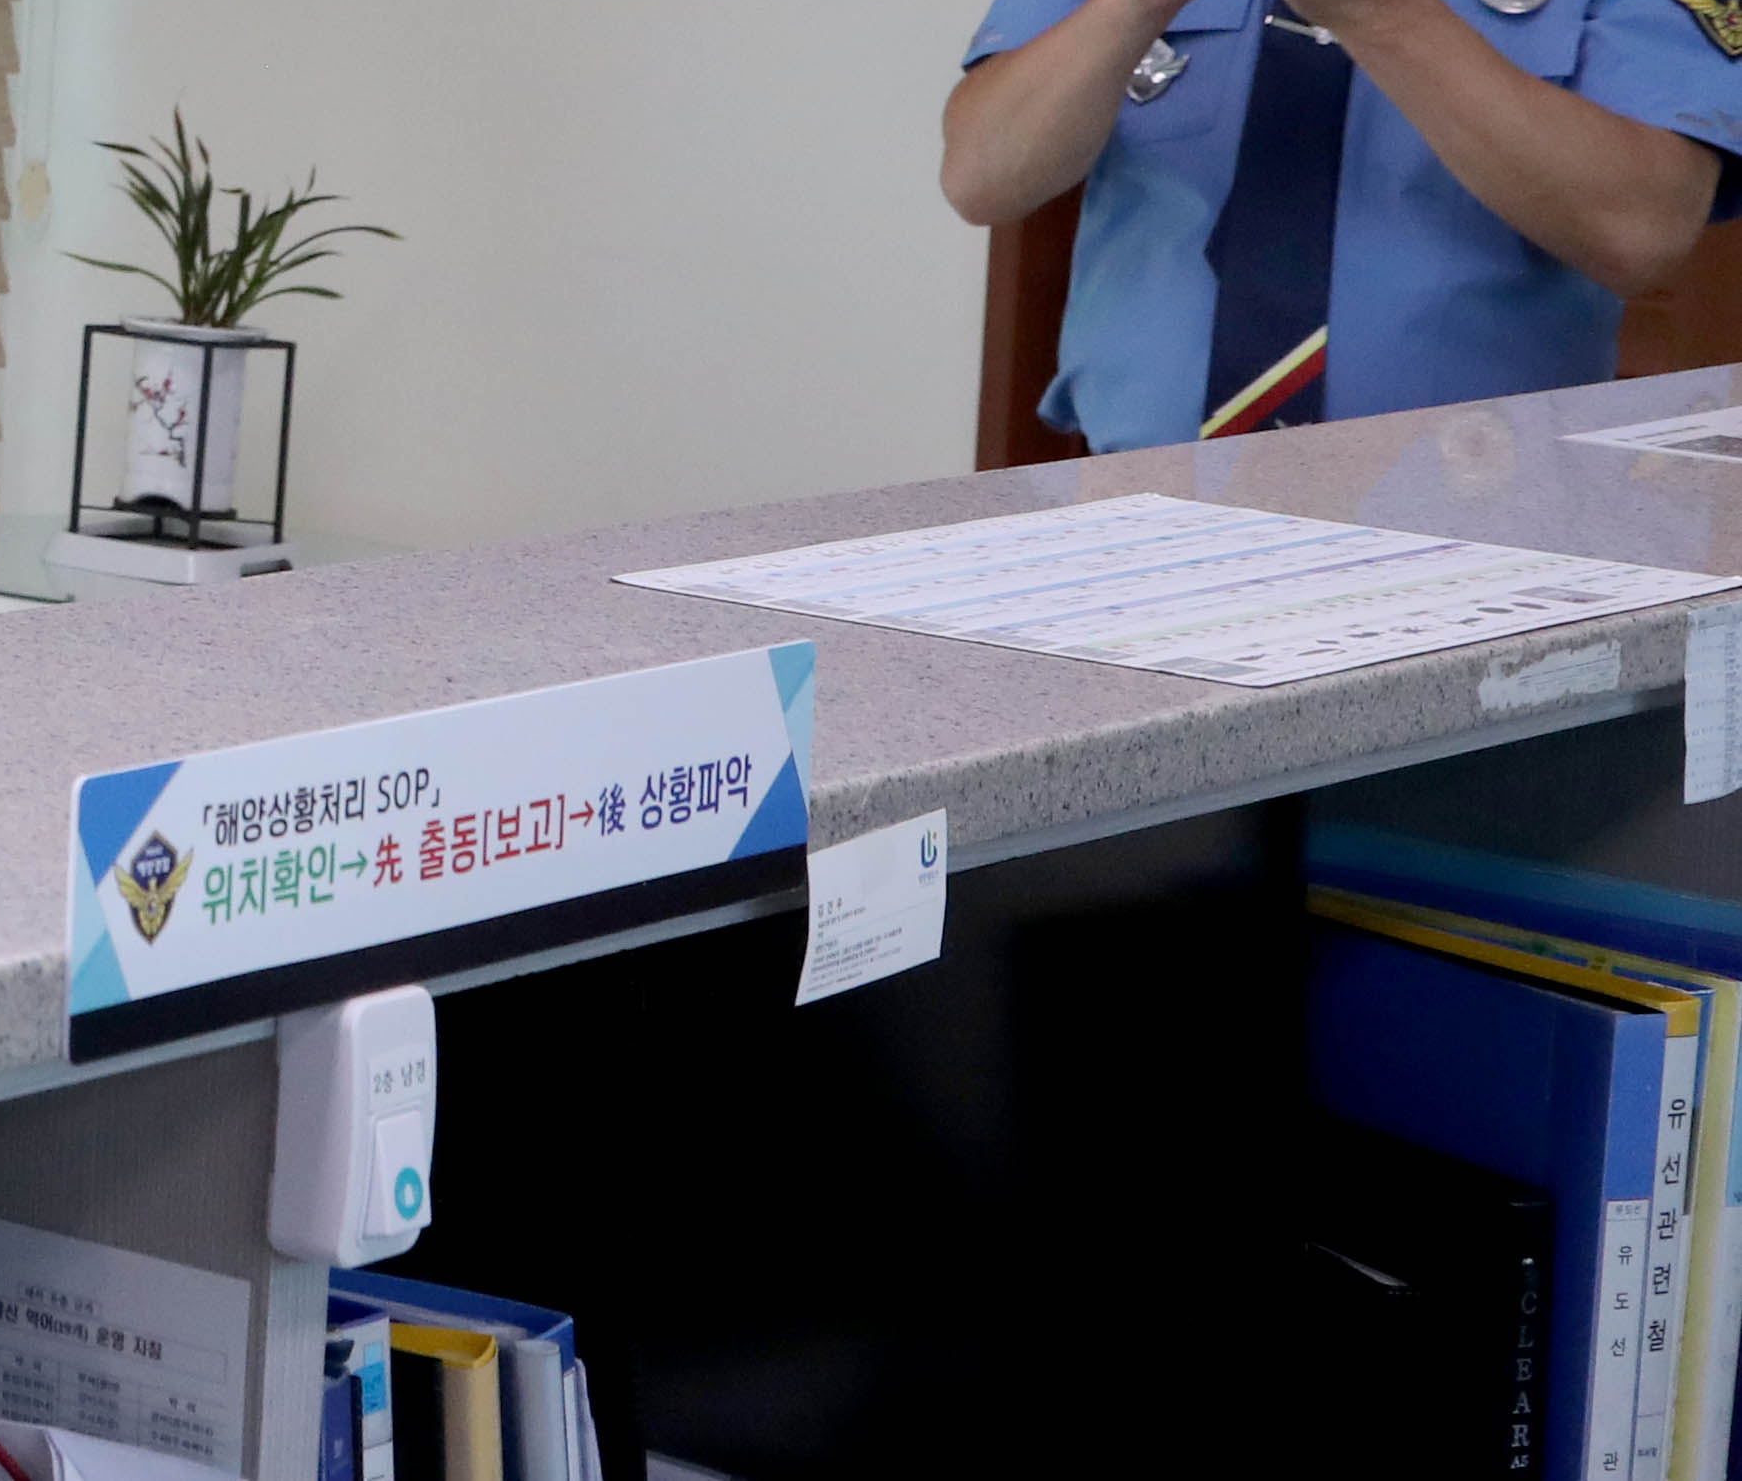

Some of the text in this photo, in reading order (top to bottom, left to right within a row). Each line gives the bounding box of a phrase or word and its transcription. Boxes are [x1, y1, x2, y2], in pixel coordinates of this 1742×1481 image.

[418, 794, 566, 881] 출동[보고]
[639, 753, 752, 830] 상황파악
[1510, 1289, 1539, 1449] CLEAR
